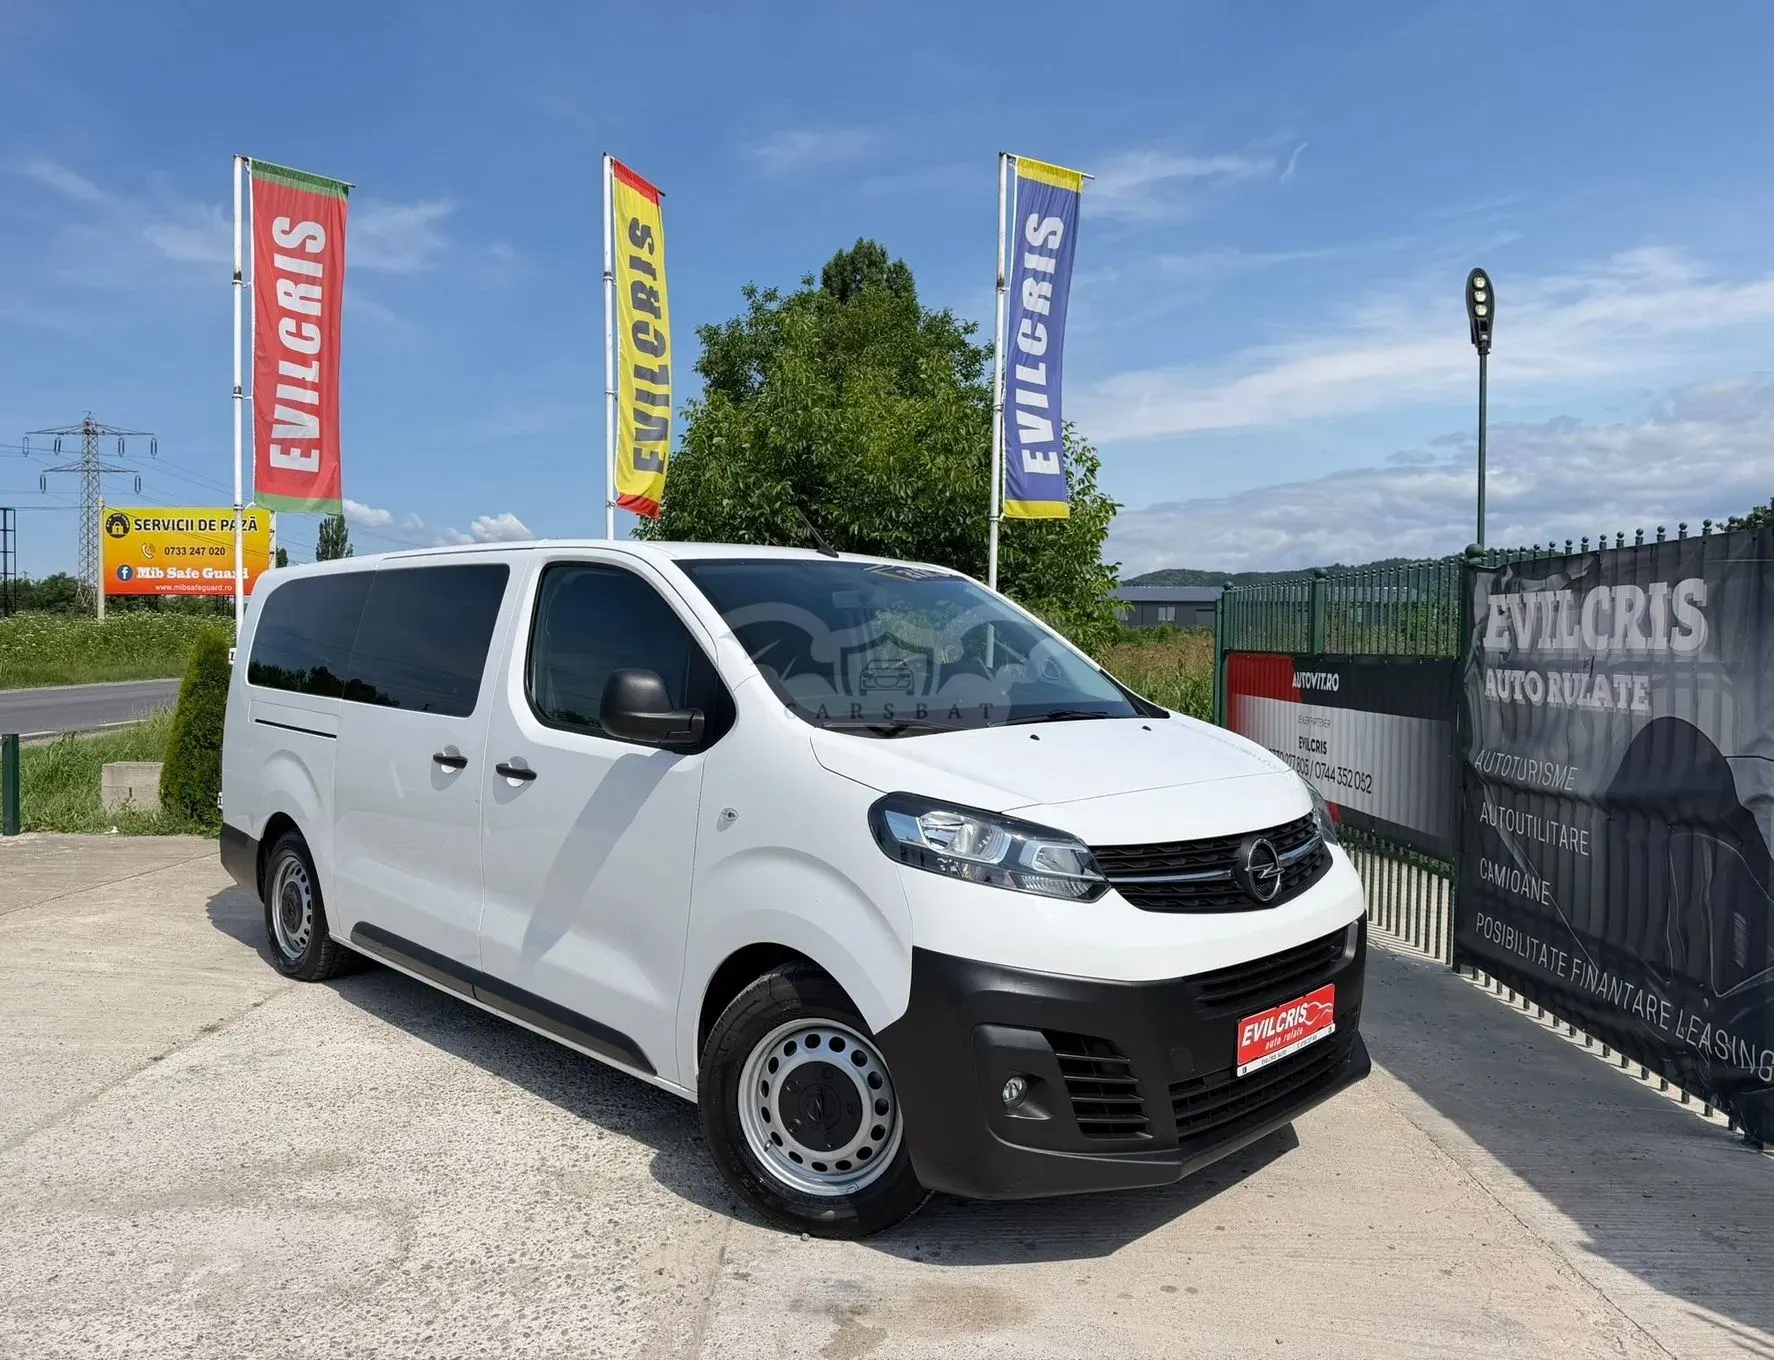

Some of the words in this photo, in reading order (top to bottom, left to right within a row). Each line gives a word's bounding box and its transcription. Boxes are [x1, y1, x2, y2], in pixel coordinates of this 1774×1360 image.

[269, 216, 326, 473] EVILCRIS
[628, 217, 670, 474] EVILCRIS
[1015, 212, 1065, 475] EVILCRIS
[134, 519, 194, 531] SERVICII
[198, 519, 216, 531] DE
[136, 566, 164, 579] Mib
[166, 566, 200, 579] Safe
[164, 547, 186, 556] 0733
[190, 547, 206, 556] 247
[209, 547, 225, 556] 020
[155, 583, 233, 592] www.mibsafeguard.ro
[1483, 577, 1709, 656] EVILCRIS
[1292, 671, 1339, 691] AUTOVIT.RO
[1484, 668, 1546, 706] AUTO
[1547, 671, 1651, 711] RULATE
[1299, 736, 1327, 756] EVILCRIS
[1314, 761, 1336, 784] 0744
[1337, 766, 1352, 788] 352
[1354, 771, 1373, 794] 052
[1474, 749, 1578, 791] AUTOTURISME
[1479, 801, 1589, 856] AUTOUTILITARE
[1479, 857, 1551, 905] CAMIOANE
[1476, 912, 1568, 978] POSIBILITATE
[1570, 957, 1672, 1030] FINANTARE
[1676, 1009, 1774, 1082] LEASING
[1241, 1002, 1308, 1047] EVILCRIS
